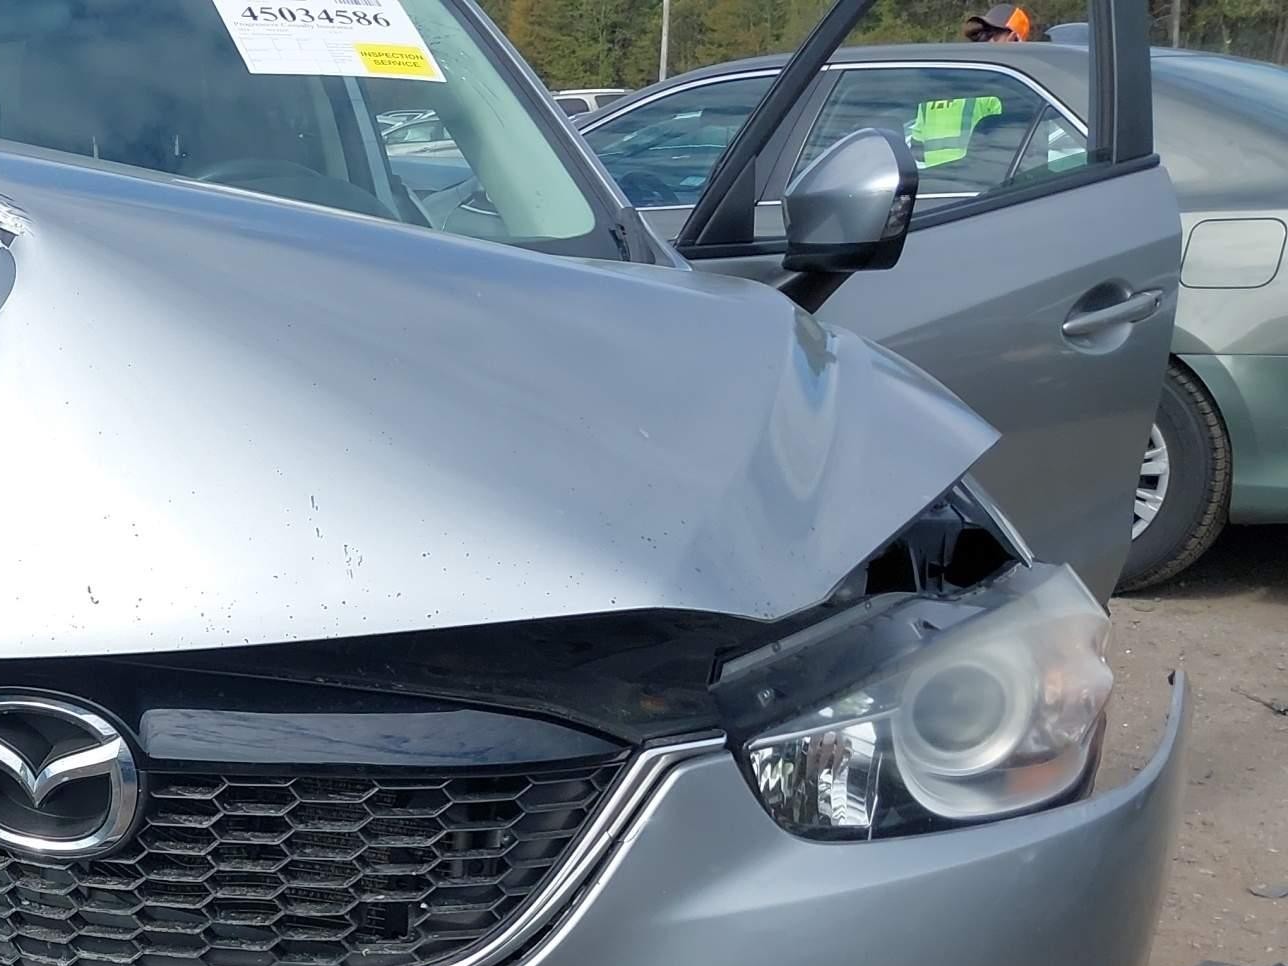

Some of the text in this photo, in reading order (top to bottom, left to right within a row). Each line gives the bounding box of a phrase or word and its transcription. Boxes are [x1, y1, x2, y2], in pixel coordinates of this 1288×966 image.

[240, 6, 391, 28] 45034586
[360, 51, 424, 60] INSPECTION
[373, 59, 422, 68] SERVICE
